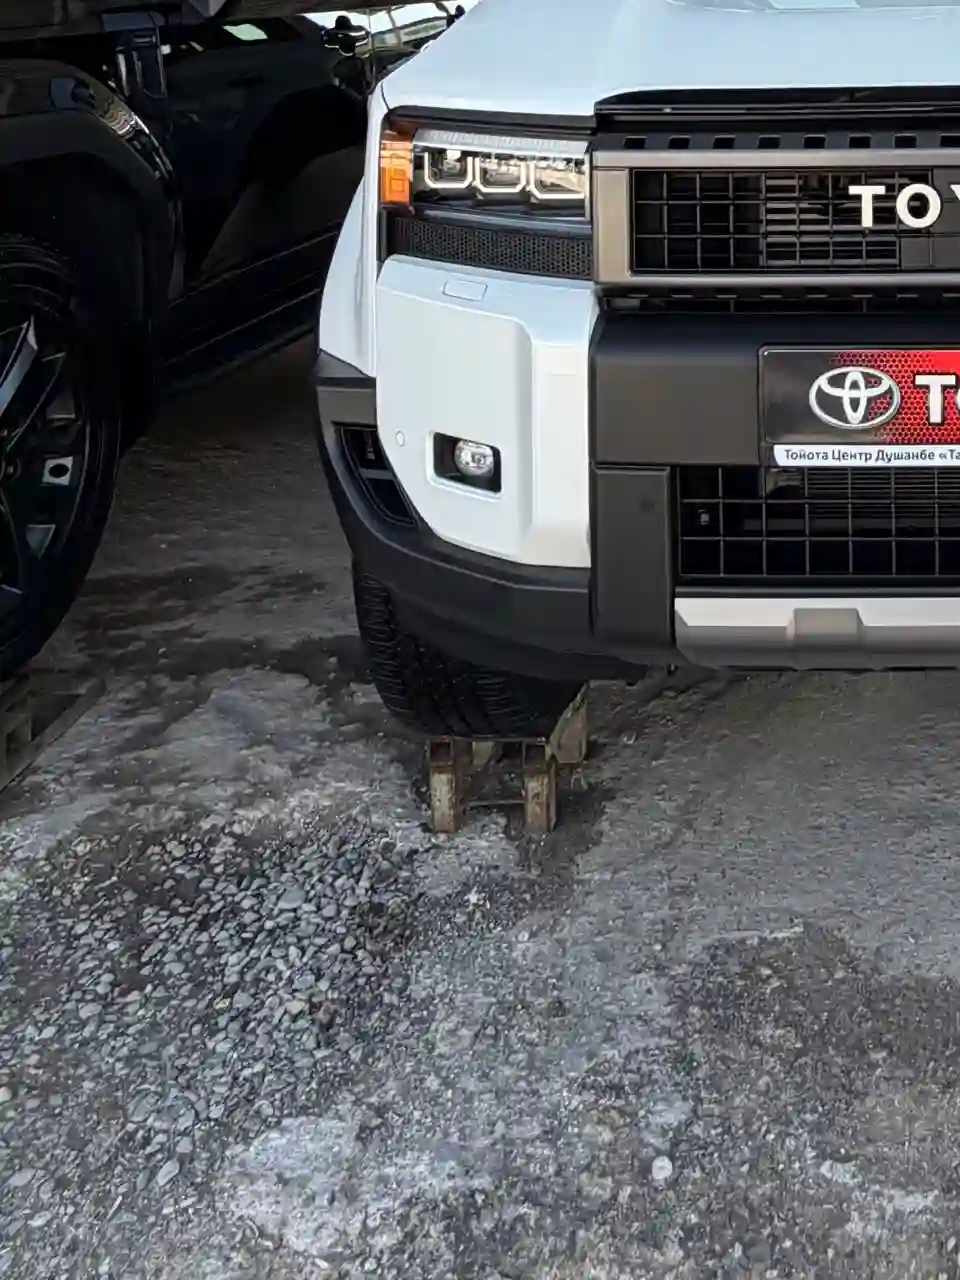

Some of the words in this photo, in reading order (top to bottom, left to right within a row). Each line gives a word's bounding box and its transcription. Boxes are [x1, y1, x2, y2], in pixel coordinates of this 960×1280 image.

[784, 448, 829, 461] Тойота
[832, 448, 873, 462] Центр
[875, 447, 935, 464] Душанбе
